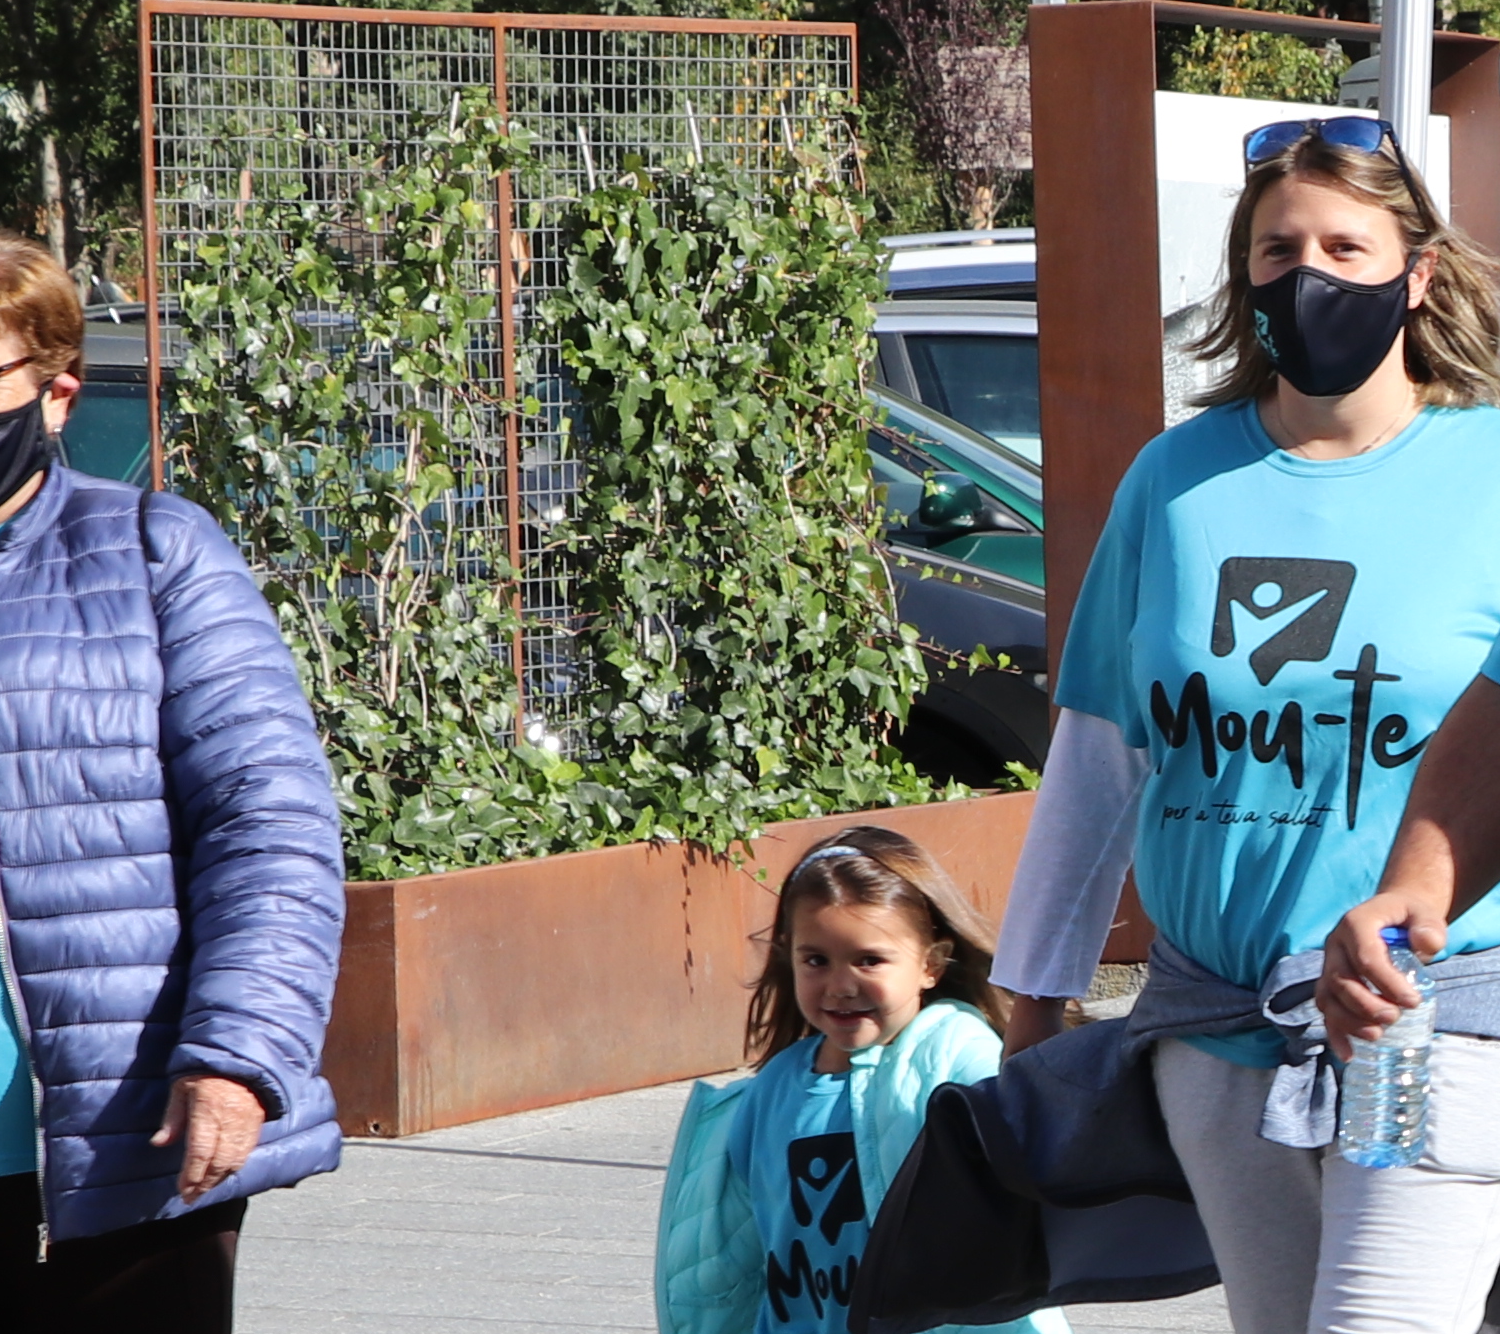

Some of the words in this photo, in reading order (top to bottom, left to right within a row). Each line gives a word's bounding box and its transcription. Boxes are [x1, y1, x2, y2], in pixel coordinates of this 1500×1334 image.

[1150, 643, 1437, 831] Mou-te
[1161, 804, 1190, 831] per
[1268, 794, 1341, 829] salut
